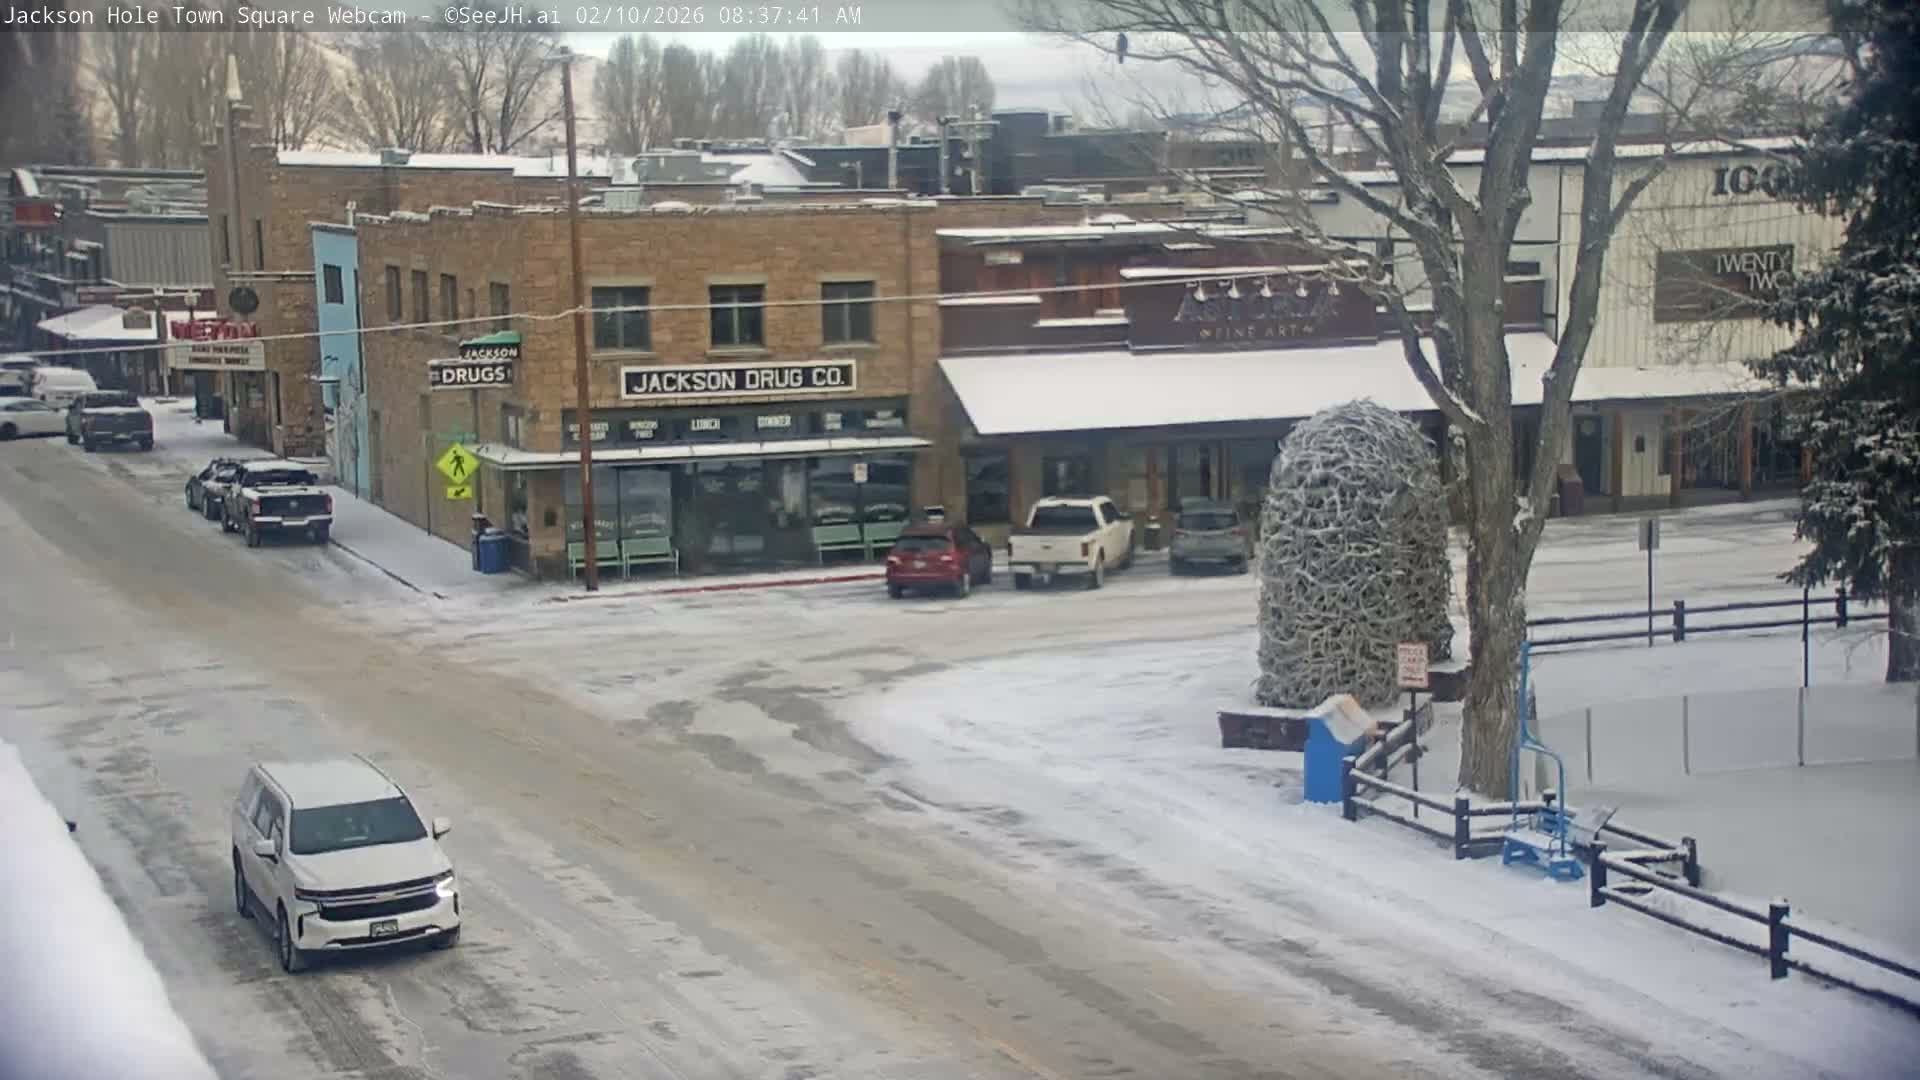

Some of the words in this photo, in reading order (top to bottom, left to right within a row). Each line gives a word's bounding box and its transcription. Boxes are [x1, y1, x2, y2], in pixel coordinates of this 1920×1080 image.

[1717, 250, 1790, 273] TWENTY
[1215, 325, 1256, 339] FINE
[1264, 323, 1298, 338] ART
[463, 347, 518, 359] JACKSON
[442, 365, 506, 385] DRUGS
[633, 370, 736, 393] JACKSON
[745, 367, 804, 389] DRUG
[812, 366, 846, 387] CO.
